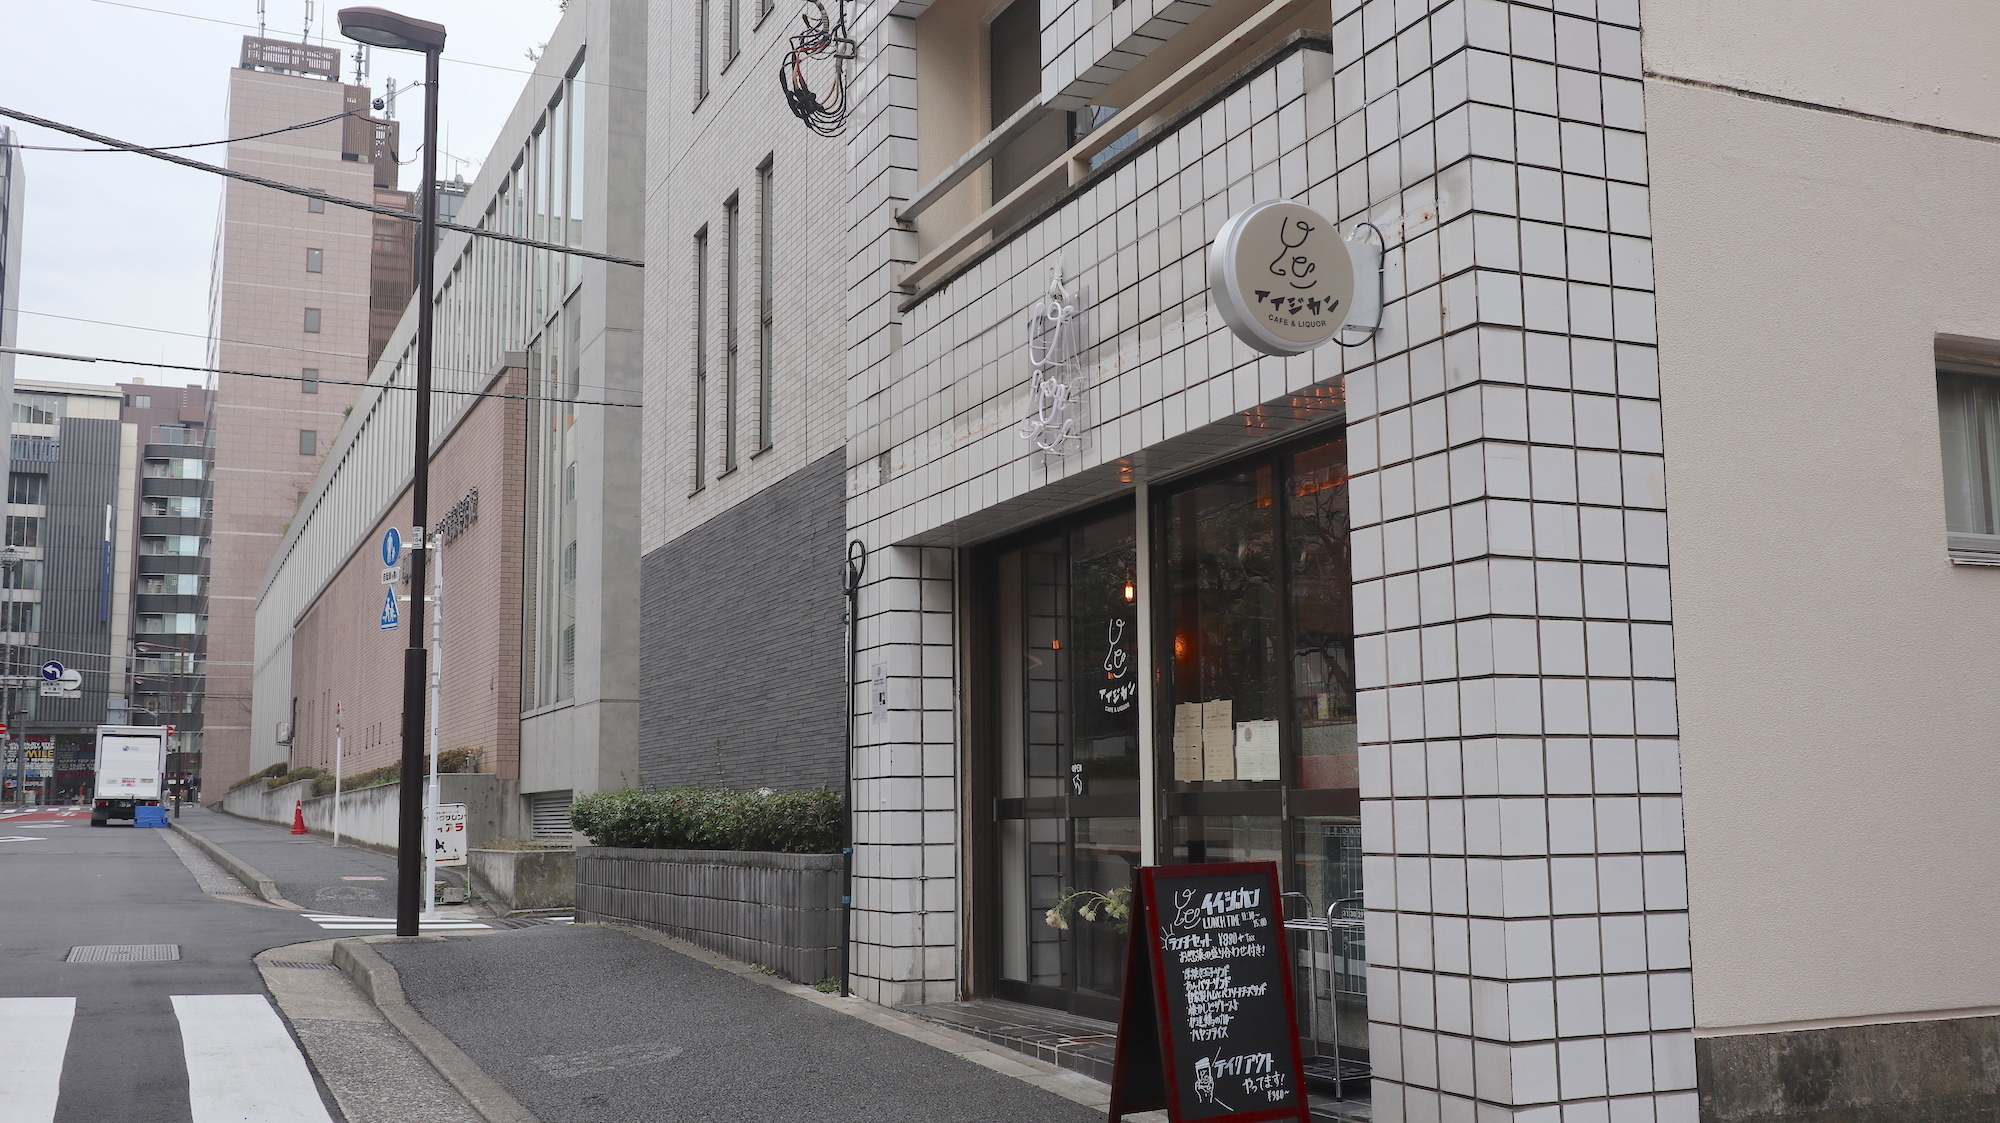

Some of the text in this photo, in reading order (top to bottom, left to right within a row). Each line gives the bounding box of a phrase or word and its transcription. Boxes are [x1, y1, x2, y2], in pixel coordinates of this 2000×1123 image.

[1268, 314, 1289, 326] CAFE
[1298, 320, 1327, 328] LIQUOR
[1071, 763, 1083, 773] OPEN
[436, 814, 464, 822] グサロン
[1202, 915, 1226, 930] LUNCH
[1226, 914, 1241, 928] TIME
[1168, 933, 1213, 950] ランチセット
[1213, 1053, 1274, 1078] テイクアウト
[1242, 1070, 1286, 1095] やってます!
